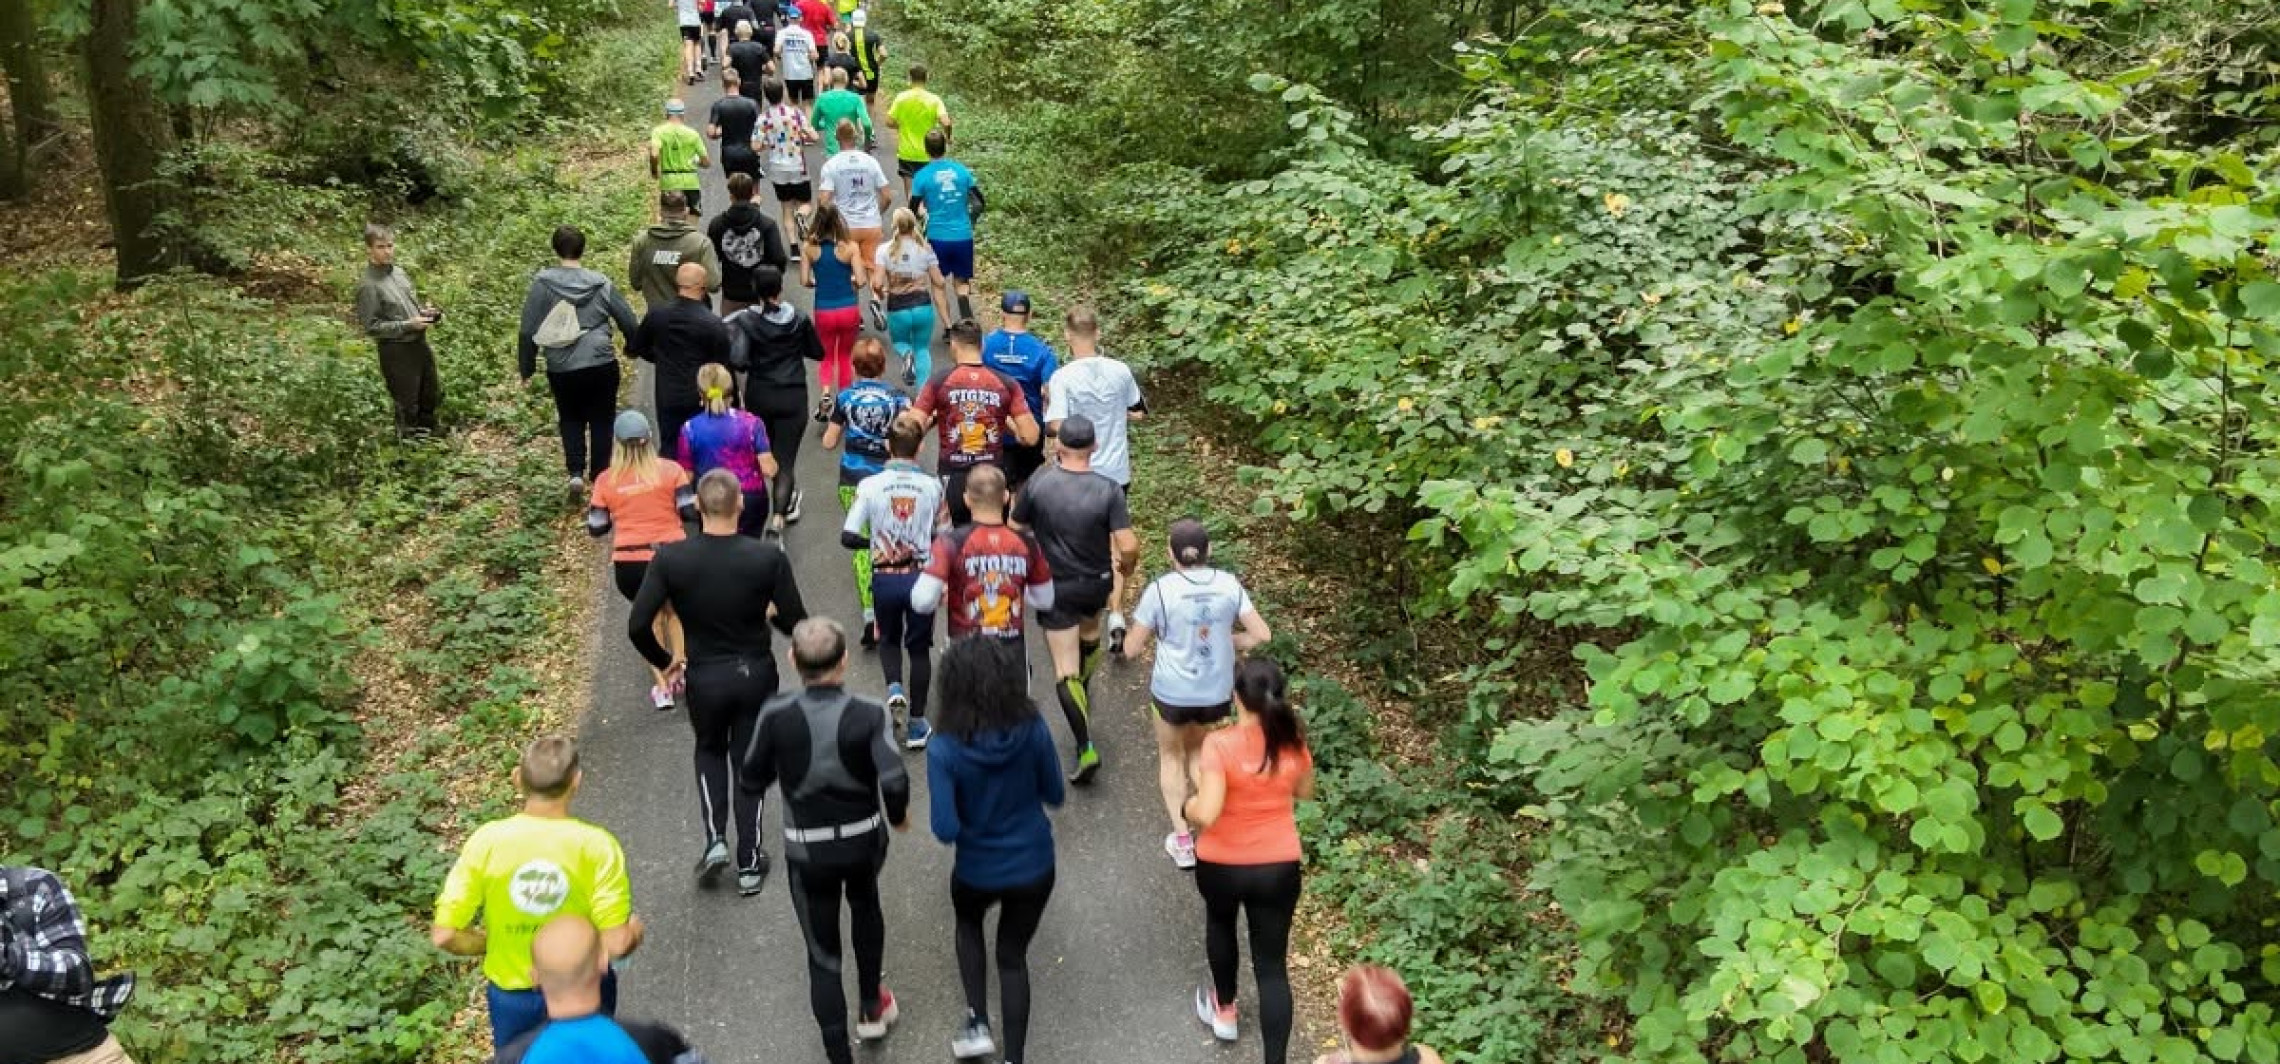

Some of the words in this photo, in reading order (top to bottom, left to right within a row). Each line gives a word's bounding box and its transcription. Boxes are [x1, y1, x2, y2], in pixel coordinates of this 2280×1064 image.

[653, 250, 682, 265] NIKE
[948, 389, 1000, 407] TIGER
[965, 555, 1027, 578] TIGER
